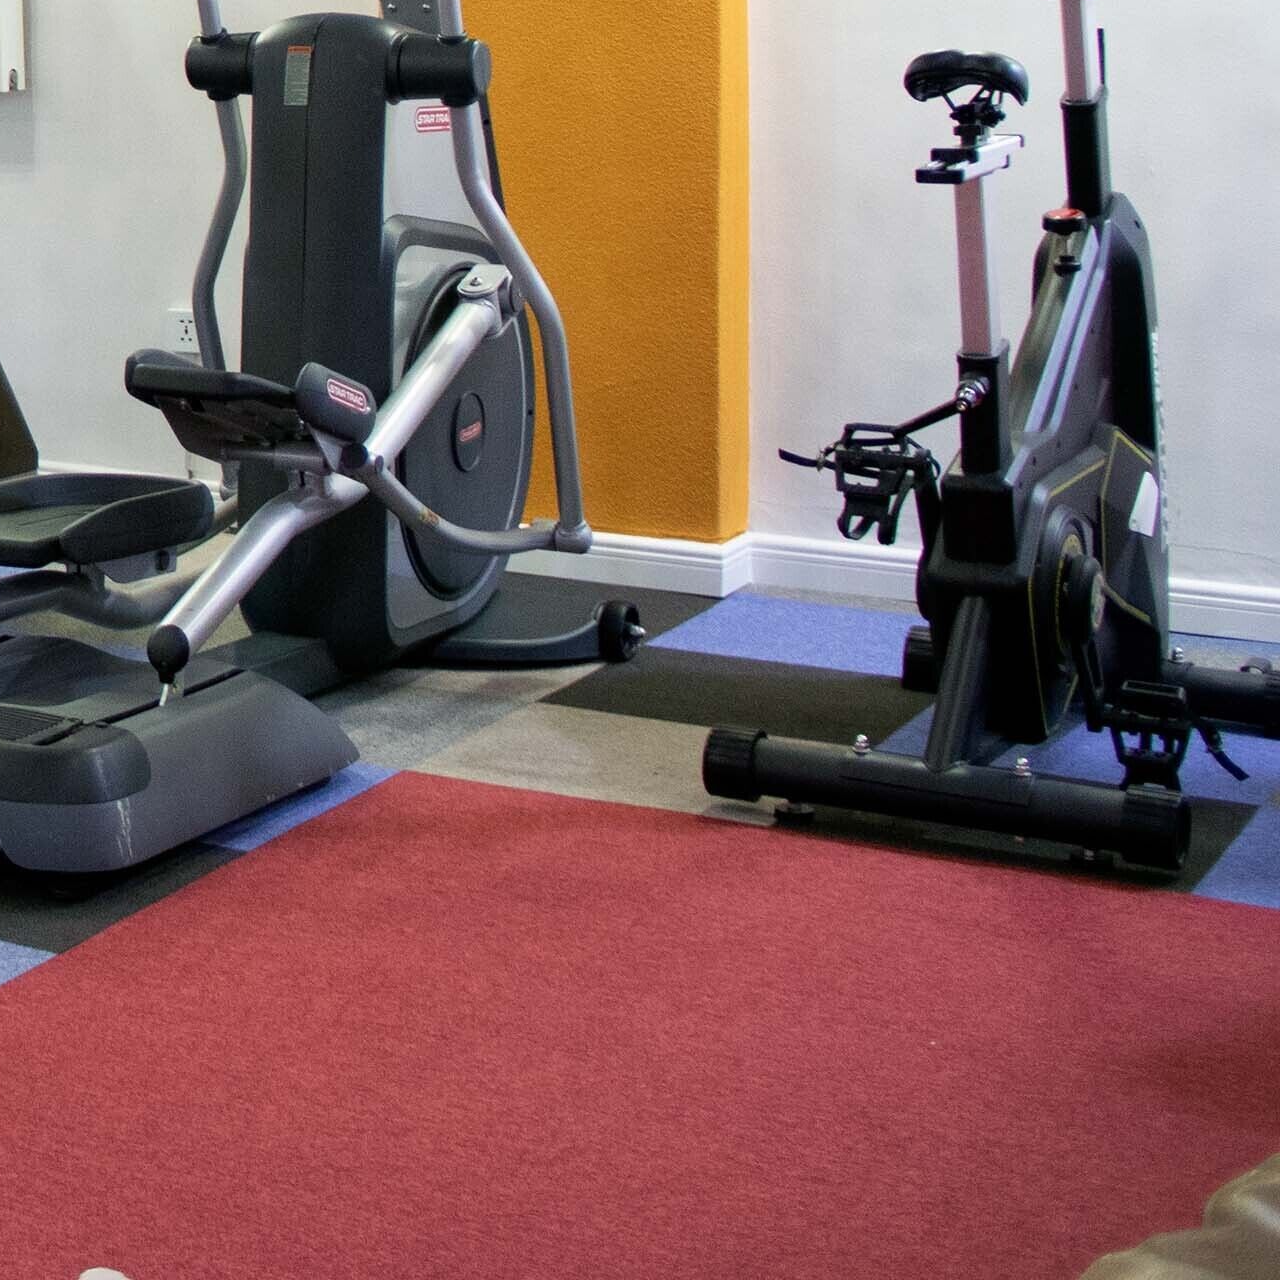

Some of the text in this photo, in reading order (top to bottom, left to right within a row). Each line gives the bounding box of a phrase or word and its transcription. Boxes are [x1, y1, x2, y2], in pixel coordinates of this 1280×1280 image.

[417, 112, 450, 124] STAR TRA
[328, 383, 365, 406] STAR TRAC
